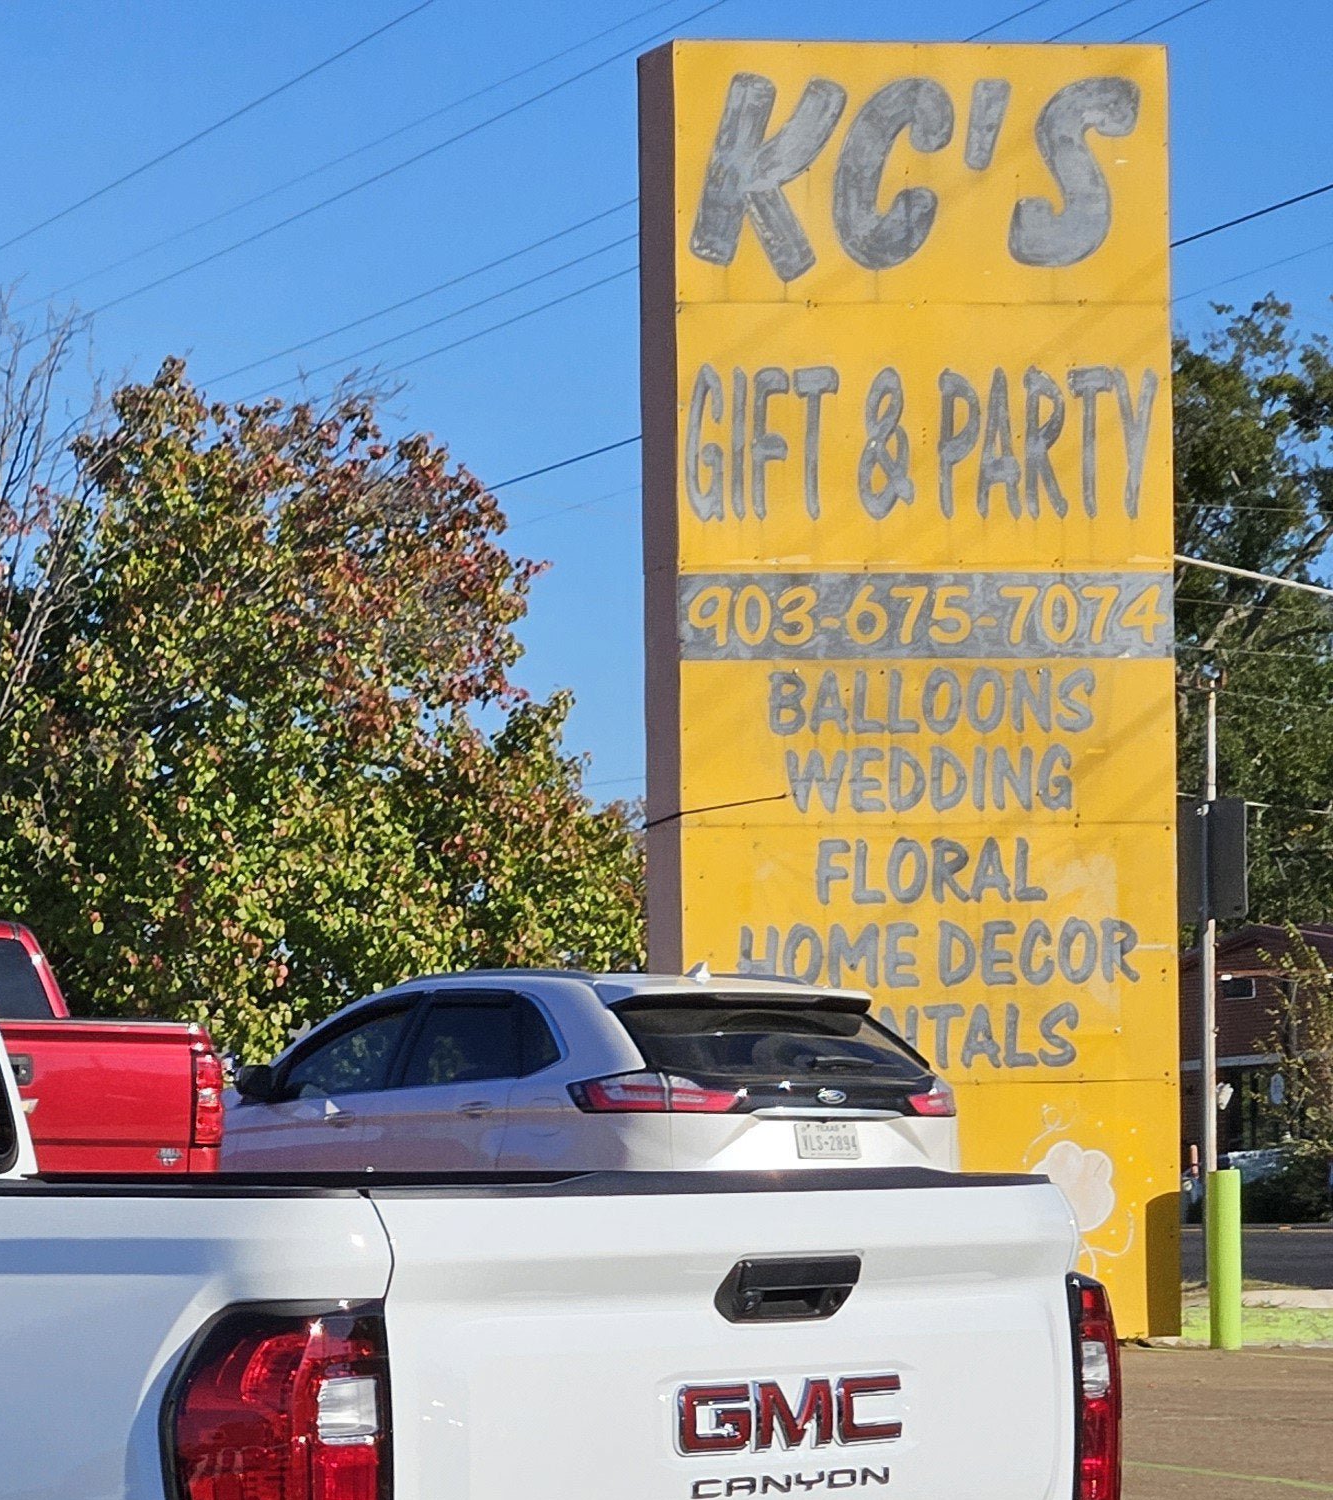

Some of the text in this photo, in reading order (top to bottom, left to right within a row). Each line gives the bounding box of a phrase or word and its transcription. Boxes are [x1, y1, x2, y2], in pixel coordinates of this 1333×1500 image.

[688, 71, 1140, 282] KC'S
[685, 362, 1157, 521] GIFT & PARTY
[687, 584, 1167, 648] 903-675-7074
[767, 666, 1096, 737] BALLOONS
[784, 742, 1073, 812] WEDDING
[815, 837, 1049, 905] FLORAL
[737, 917, 1140, 989] HOME DECOR
[879, 1001, 1079, 1071] NTALS
[675, 1370, 902, 1457] GMC
[691, 1466, 890, 1500] CANYON
